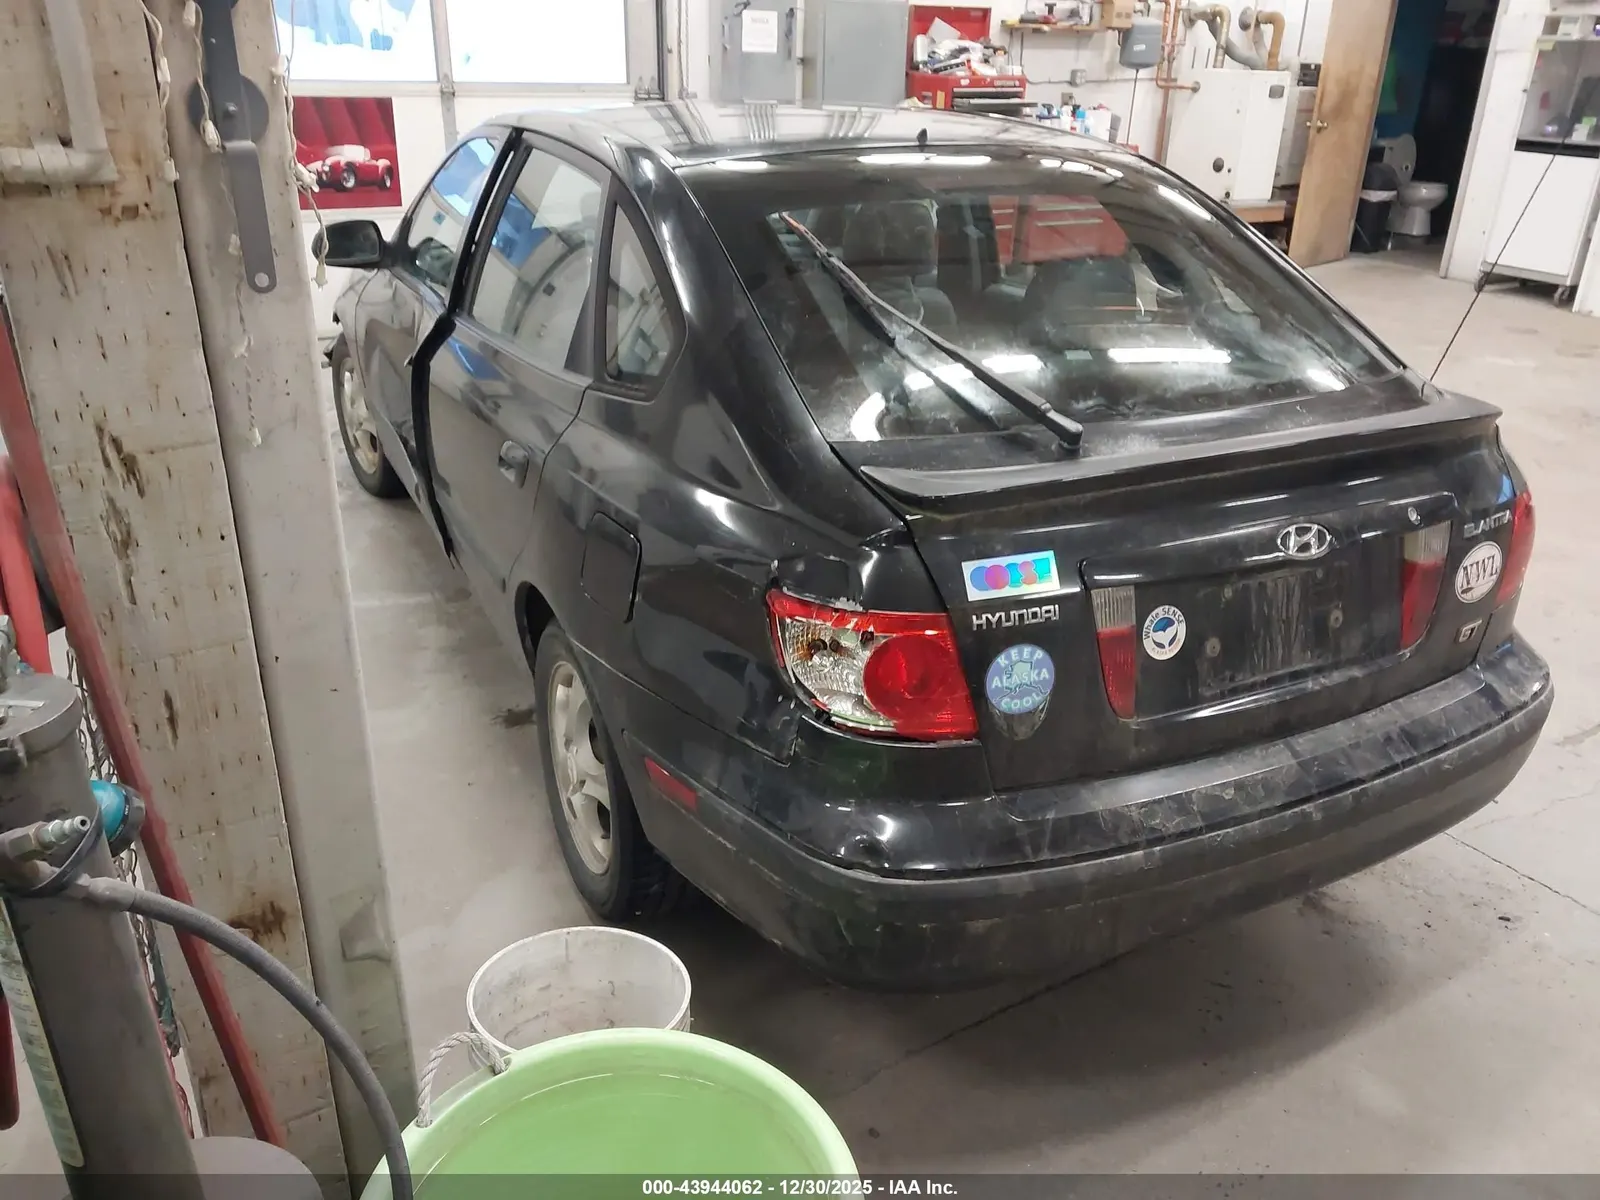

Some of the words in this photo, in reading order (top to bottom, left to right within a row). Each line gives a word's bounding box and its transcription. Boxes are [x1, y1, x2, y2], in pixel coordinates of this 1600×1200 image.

[972, 604, 1059, 631] HYUNDAI
[1143, 612, 1160, 641] Whale
[998, 647, 1044, 667] KEEP
[991, 668, 1050, 689] ALASKA
[1001, 692, 1042, 710] COOL
